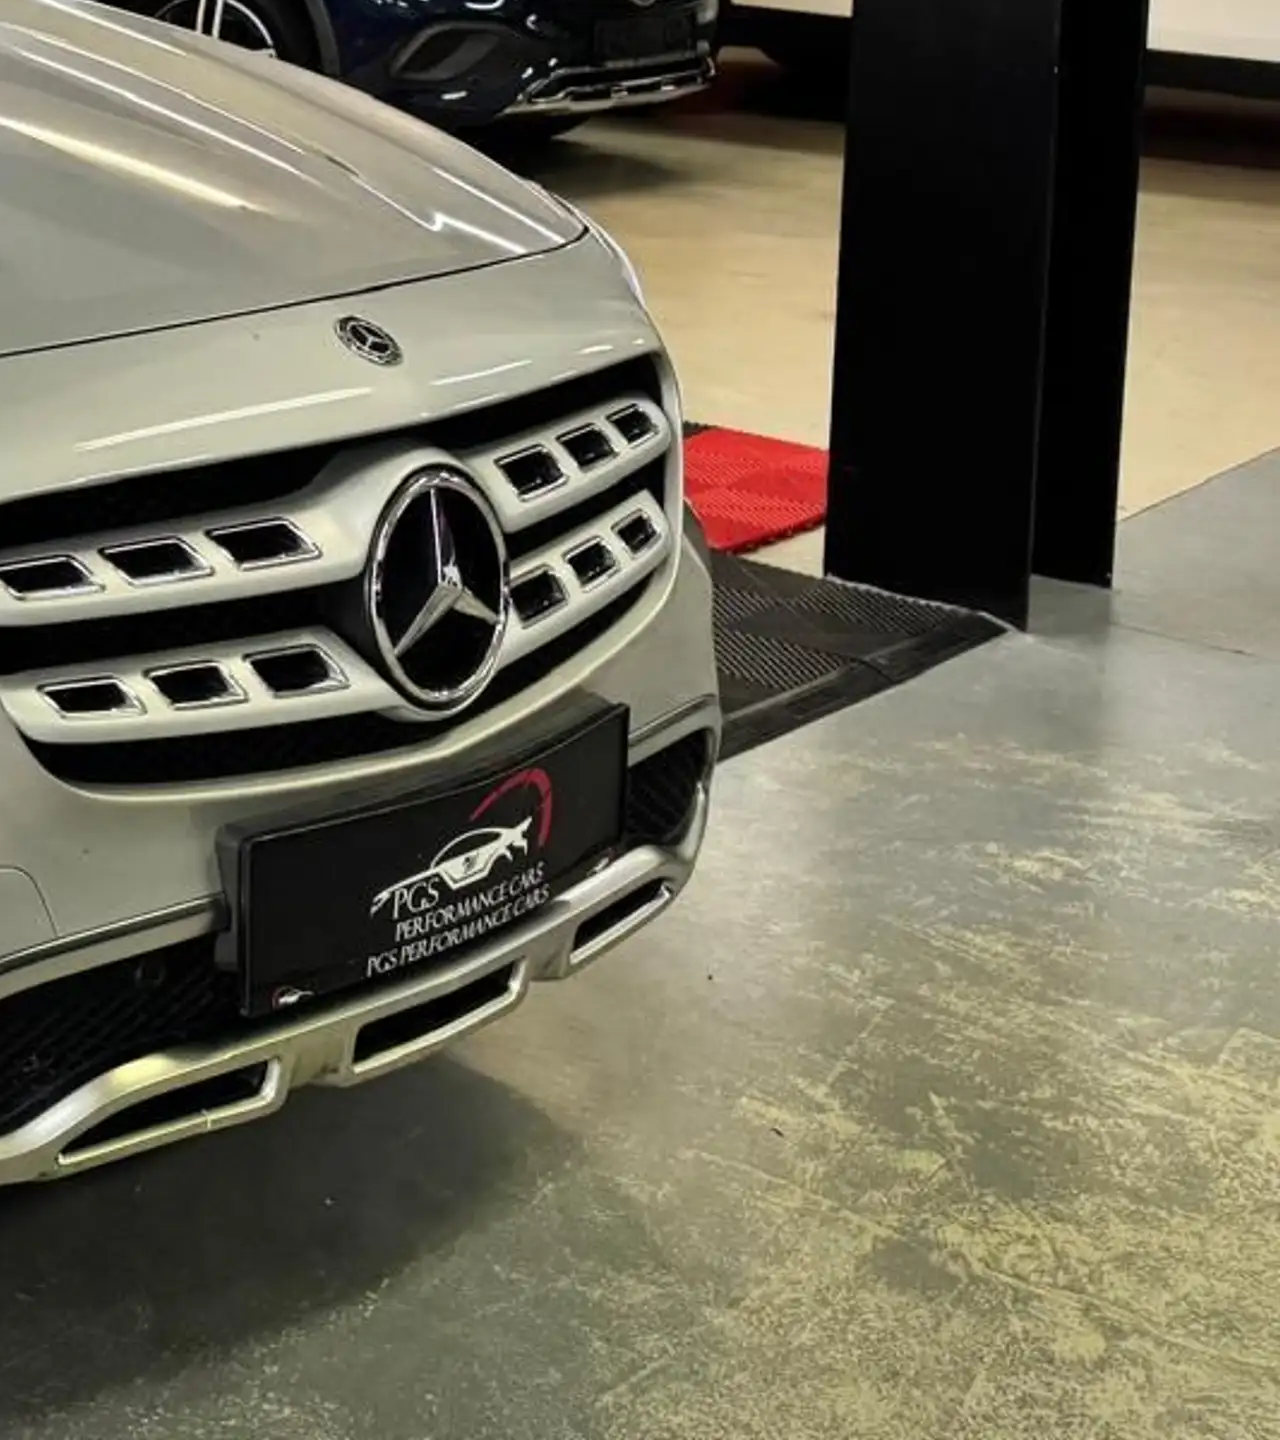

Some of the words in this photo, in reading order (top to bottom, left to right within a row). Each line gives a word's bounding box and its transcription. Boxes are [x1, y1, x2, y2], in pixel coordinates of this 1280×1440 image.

[366, 949, 398, 978] PGS
[400, 902, 512, 966] PERFORMANCE
[514, 884, 551, 917] CARS
[393, 877, 440, 919] PGS
[395, 880, 506, 942] PERFORMANCE
[510, 861, 545, 896] CARS
